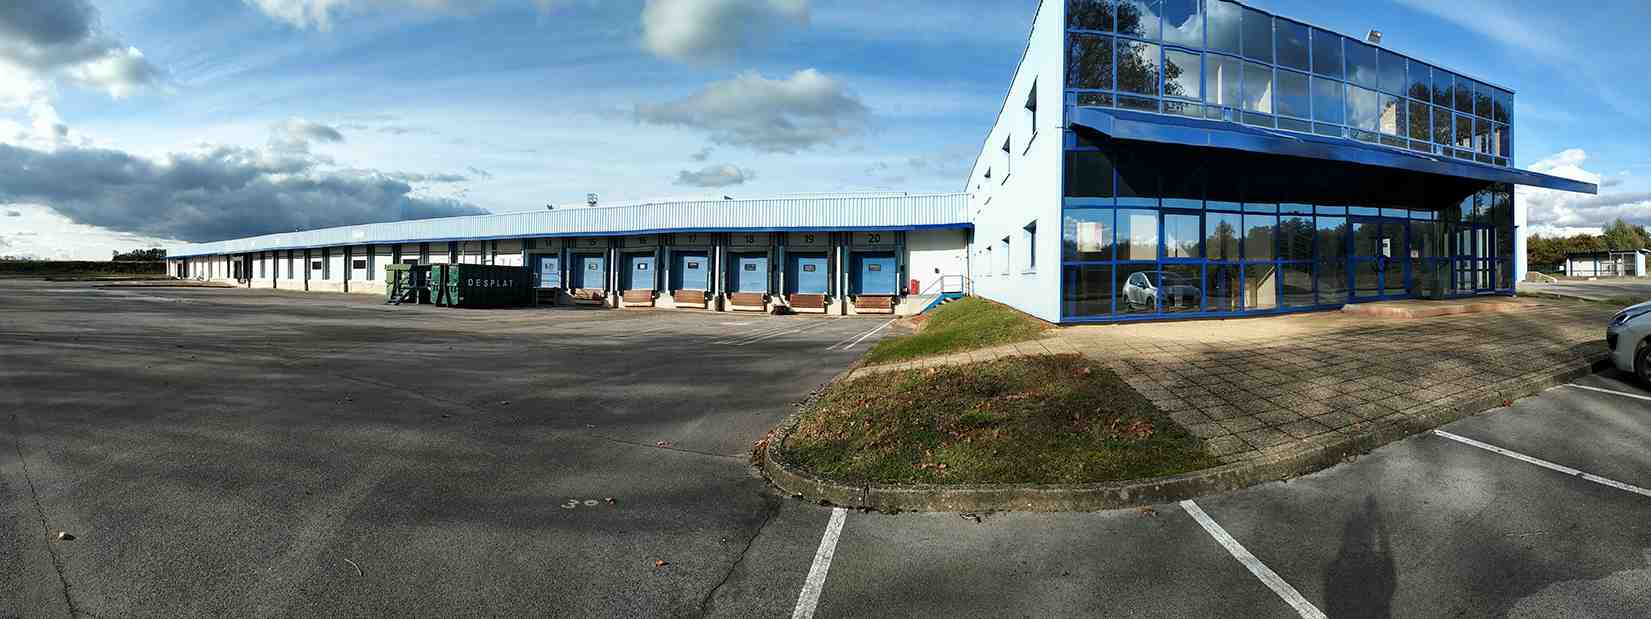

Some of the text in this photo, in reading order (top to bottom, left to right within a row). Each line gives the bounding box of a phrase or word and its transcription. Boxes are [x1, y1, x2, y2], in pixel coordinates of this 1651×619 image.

[805, 234, 815, 243] 19
[868, 233, 881, 243] 20
[467, 278, 513, 288] DESPLAT
